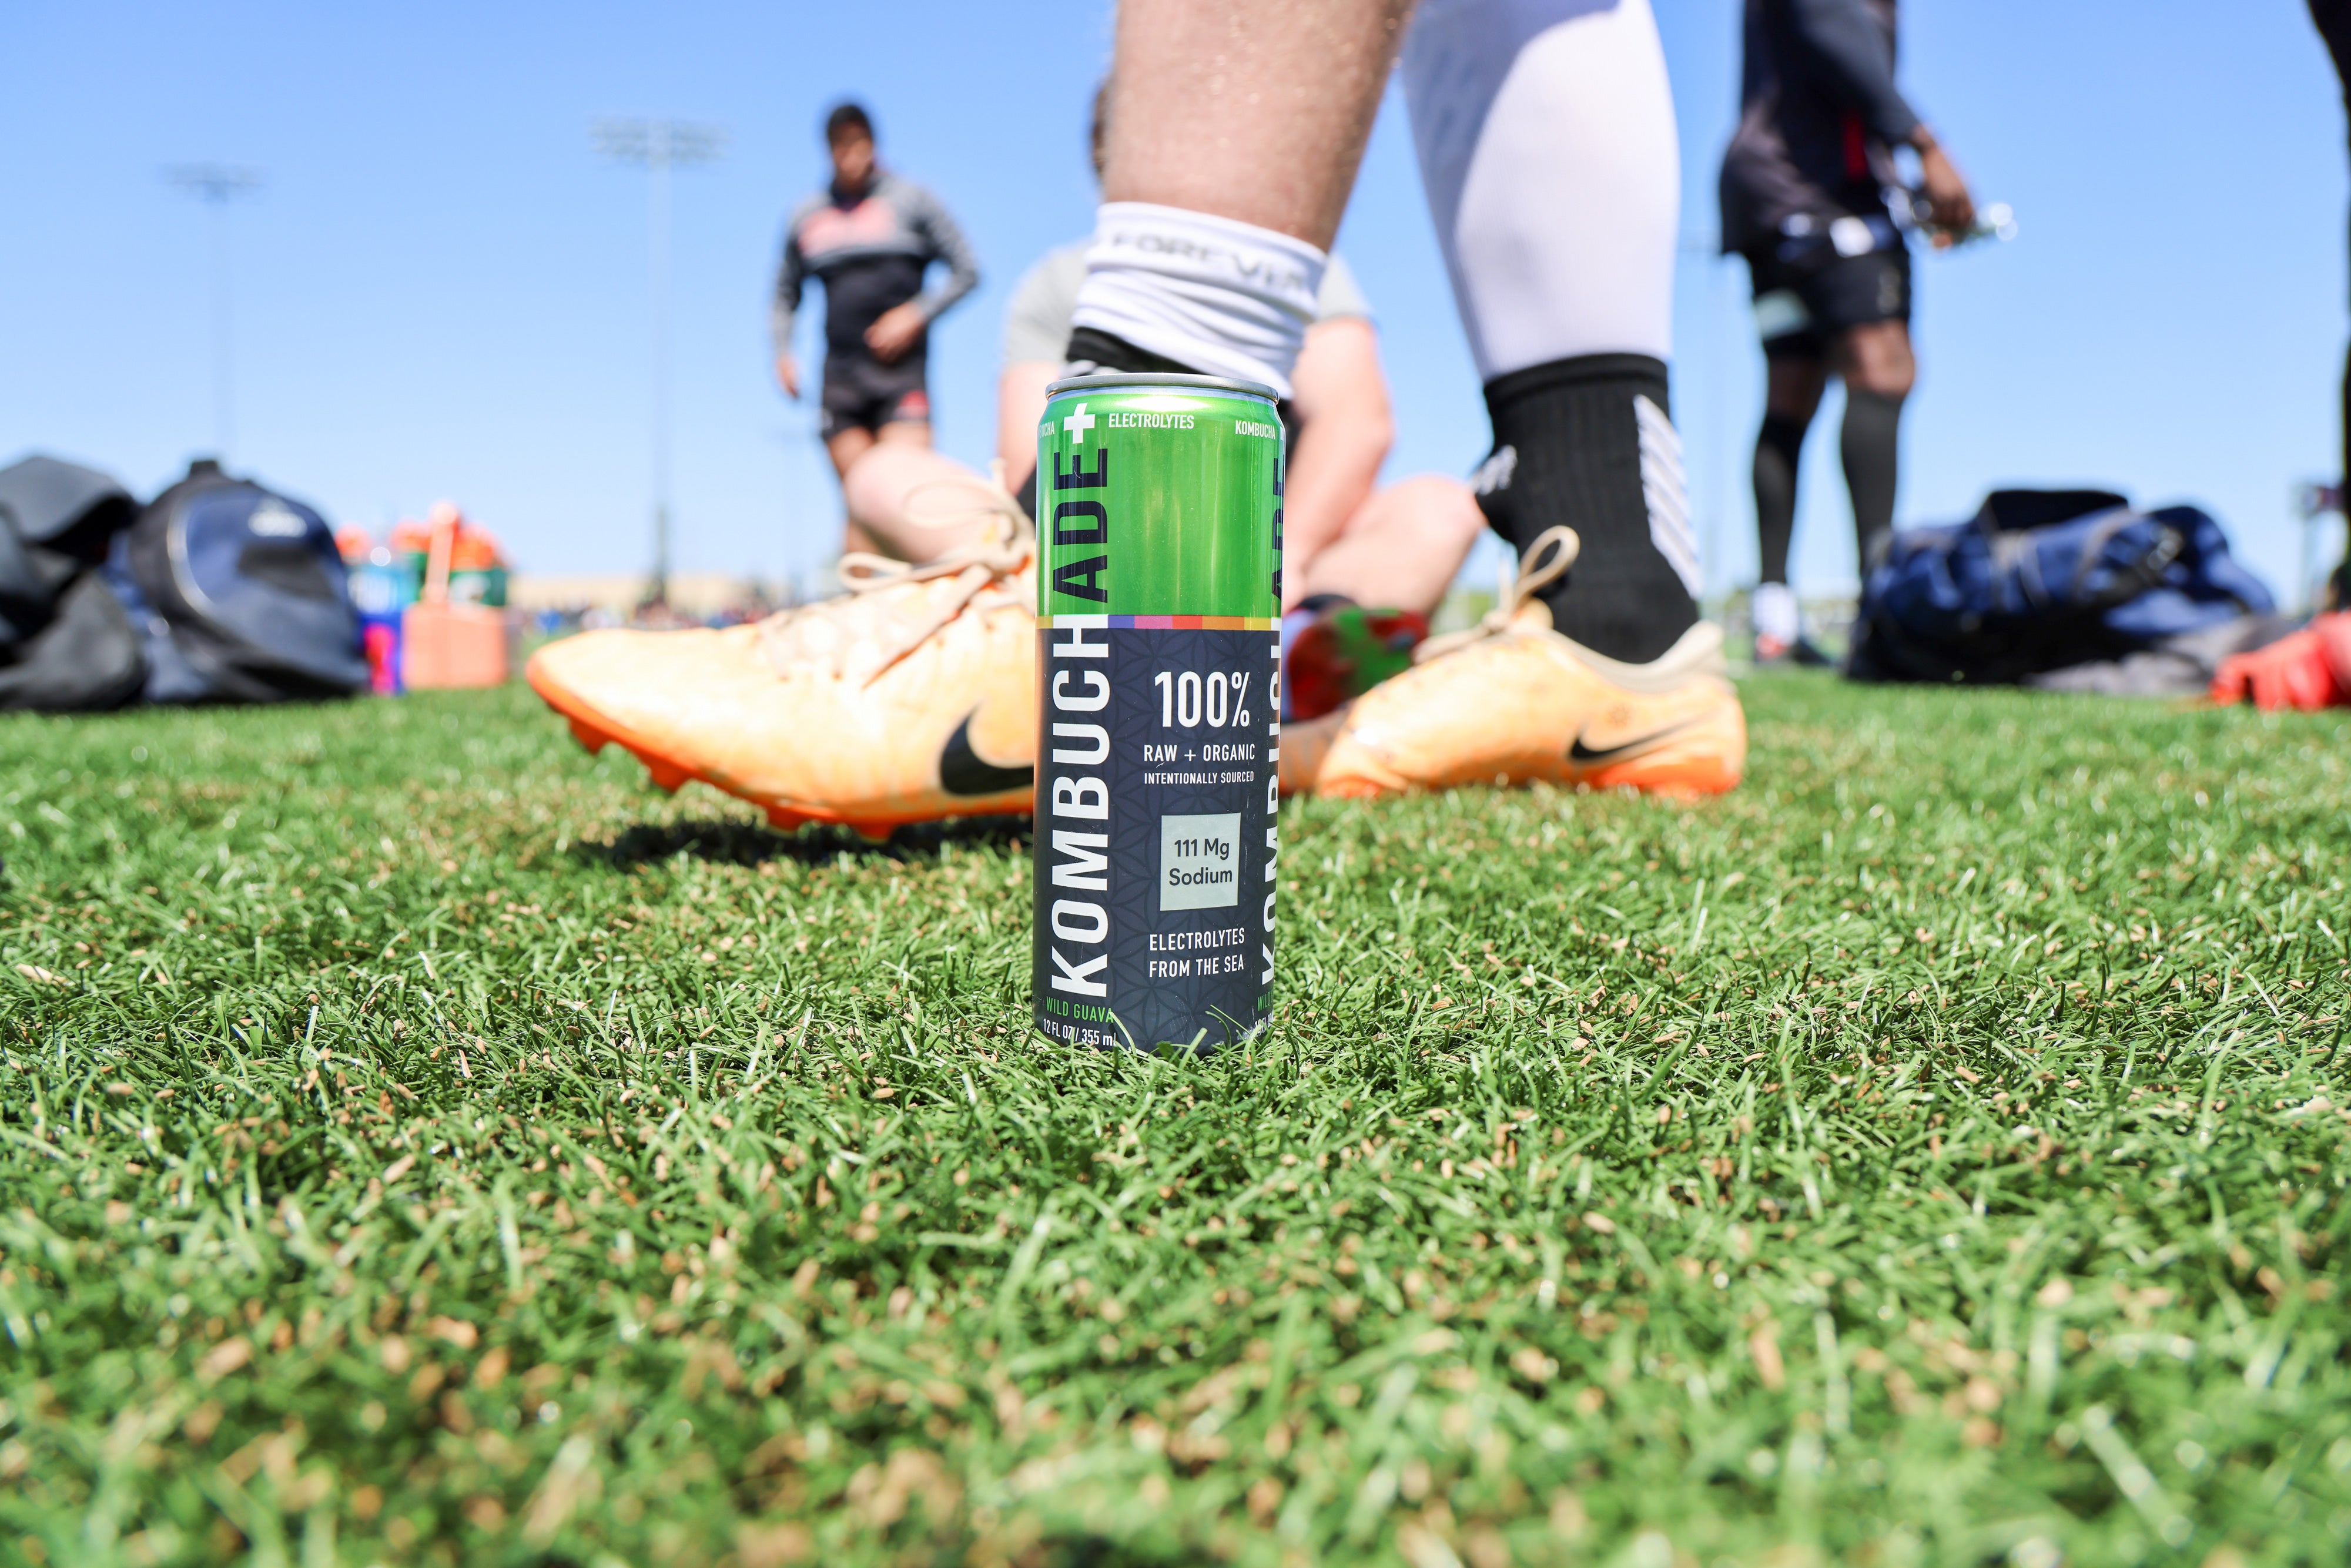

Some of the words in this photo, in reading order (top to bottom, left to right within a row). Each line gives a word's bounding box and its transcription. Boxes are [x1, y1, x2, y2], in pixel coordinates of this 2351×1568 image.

[1108, 413, 1194, 429] ELECTROLYTES
[1235, 419, 1275, 440] KOMBUCHA
[1154, 671, 1250, 728] 100%
[1144, 744, 1177, 762] RAW
[1203, 743, 1255, 762] ORGANIC
[1144, 772, 1218, 785] INTENTIONALLY
[1220, 770, 1254, 783] SOURCED
[1174, 839, 1198, 857] 111
[1204, 838, 1230, 860] Mg
[1169, 867, 1233, 886] Sodium
[1149, 927, 1245, 951] ELECTROLYTES
[1149, 959, 1191, 978] FROM
[1195, 957, 1220, 976] THE
[1224, 954, 1244, 973] SEA
[1046, 996, 1069, 1017] WILD
[1073, 1003, 1114, 1023] GUAVA
[1043, 1018, 1051, 1034] 12
[1051, 1021, 1061, 1037] FL
[1081, 1028, 1100, 1045] 355
